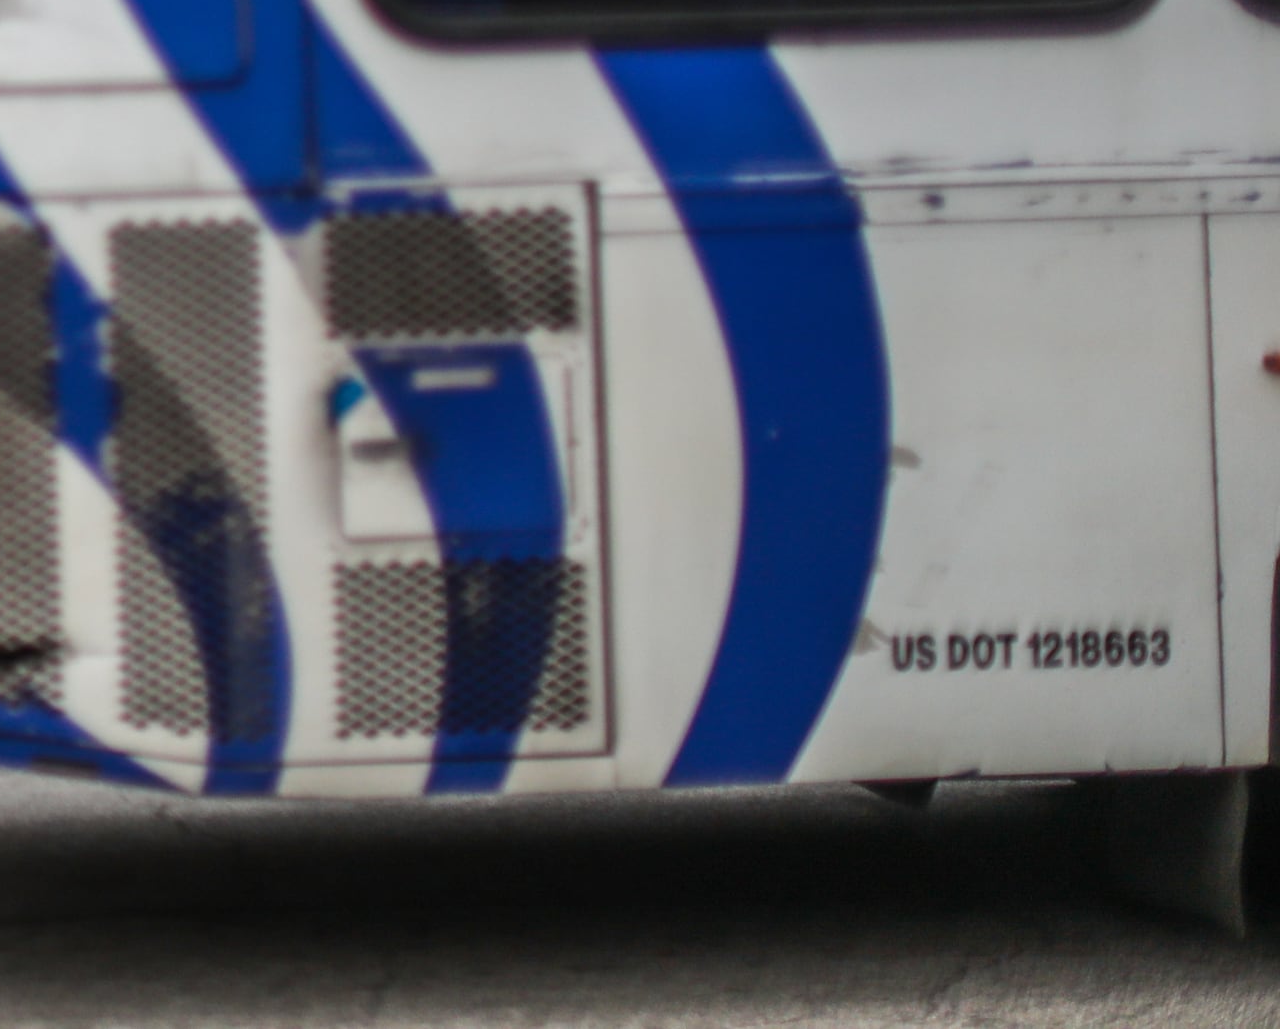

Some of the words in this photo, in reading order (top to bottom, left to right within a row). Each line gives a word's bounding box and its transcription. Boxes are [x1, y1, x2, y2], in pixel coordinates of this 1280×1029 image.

[891, 634, 937, 672] US
[948, 632, 1018, 670] DOT
[1026, 628, 1171, 669] 1218663
